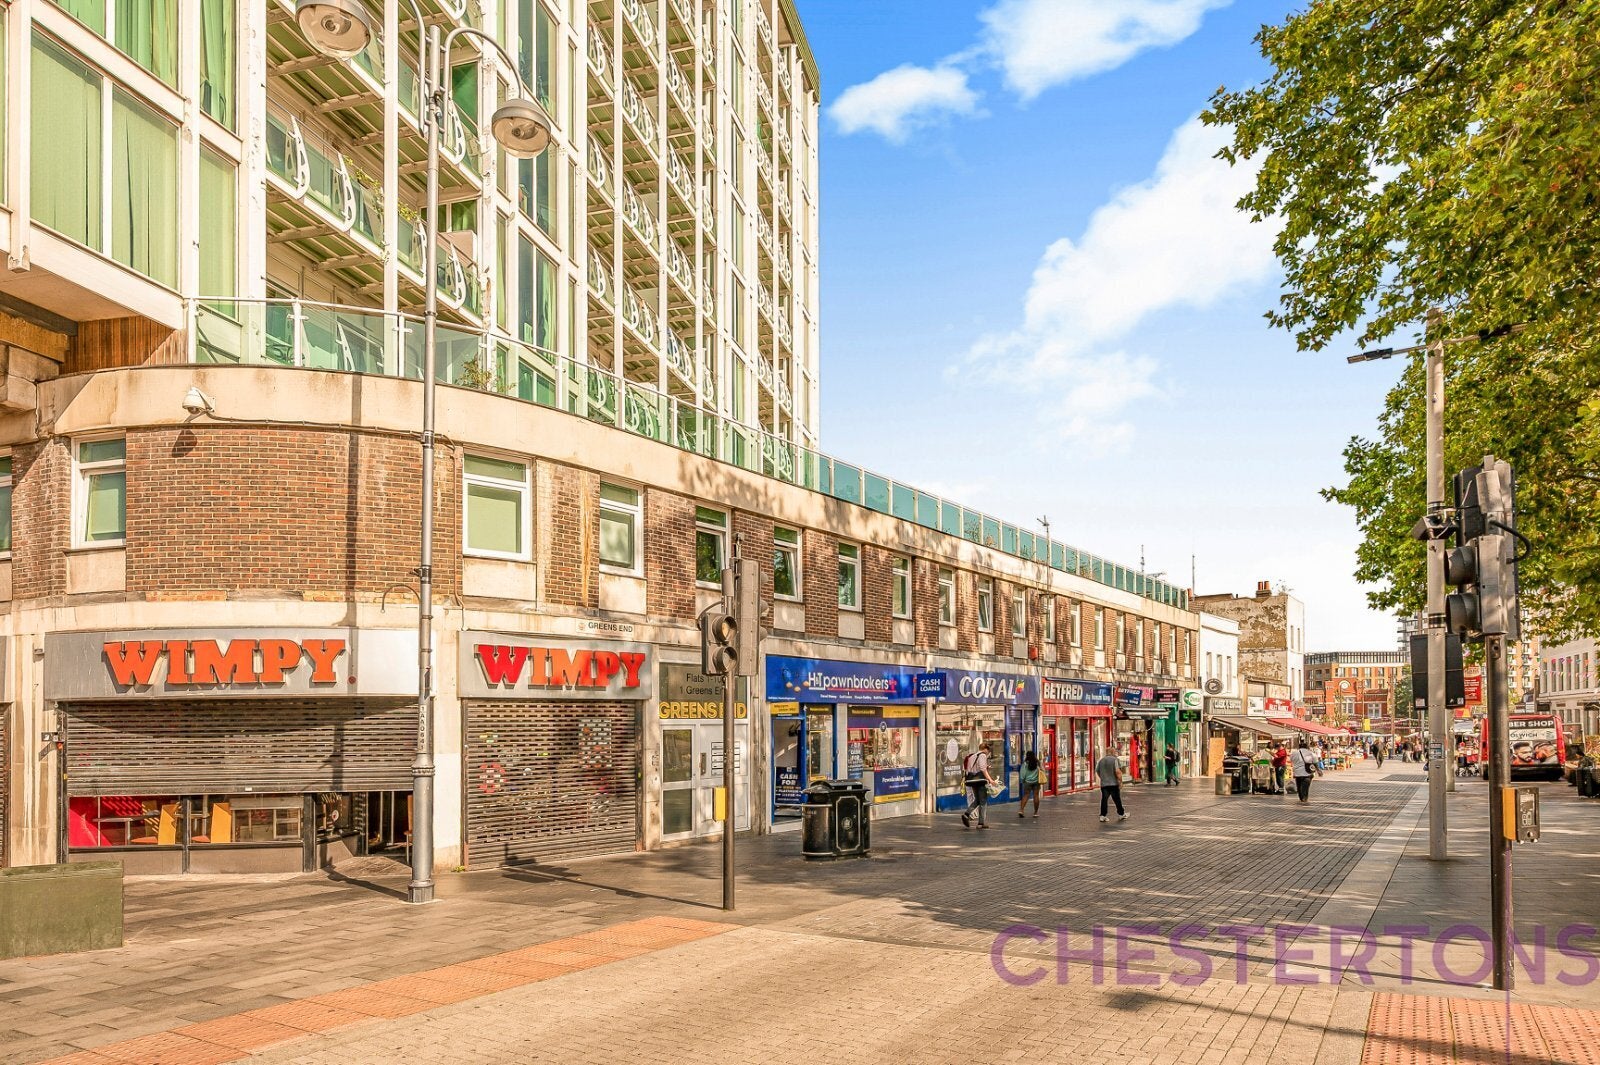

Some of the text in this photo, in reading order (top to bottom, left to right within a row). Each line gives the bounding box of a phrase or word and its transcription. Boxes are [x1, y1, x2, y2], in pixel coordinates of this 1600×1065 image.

[588, 622, 633, 633] GREENS END
[103, 639, 346, 685] WIMPY
[474, 644, 646, 688] WIMPY
[686, 673, 705, 682] Flats
[823, 675, 889, 690] pawnbrokers
[680, 686, 683, 694] 1
[686, 686, 713, 695] Greens
[959, 676, 1016, 699] CORAL
[1043, 682, 1083, 700] BETFRED
[659, 702, 747, 719] GREENS ED
